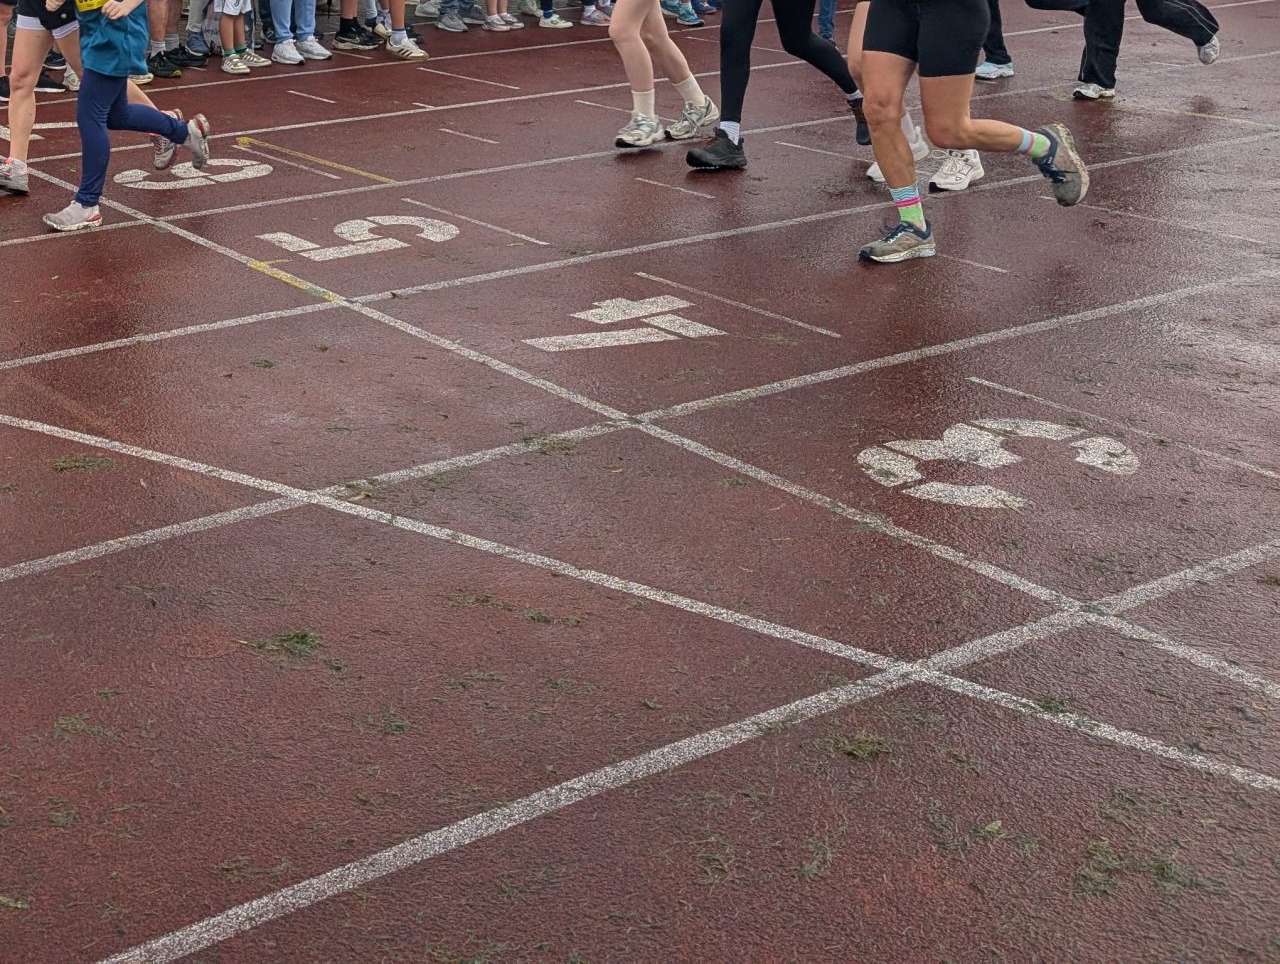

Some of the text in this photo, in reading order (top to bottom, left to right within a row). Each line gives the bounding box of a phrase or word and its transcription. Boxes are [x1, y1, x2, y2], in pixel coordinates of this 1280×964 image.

[256, 215, 460, 262] 5
[521, 294, 729, 352] 4
[856, 418, 1141, 509] 3
